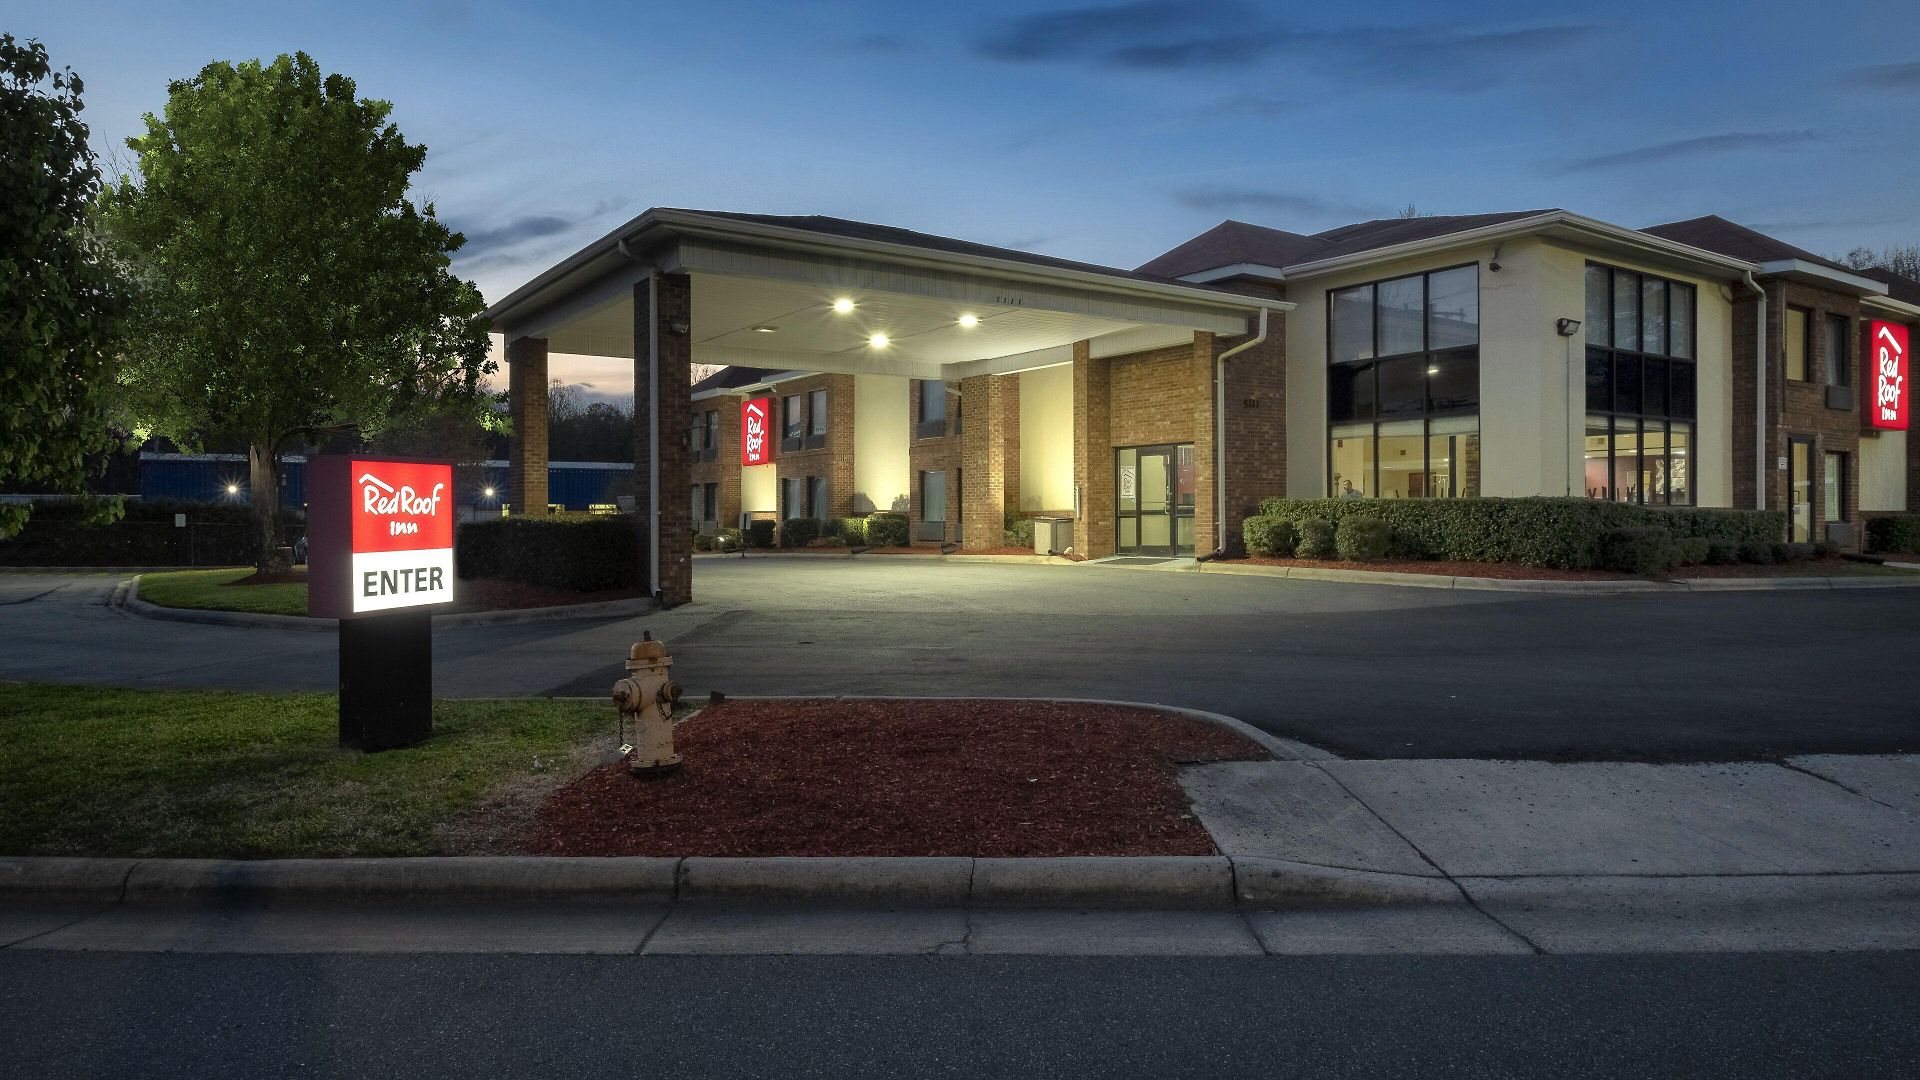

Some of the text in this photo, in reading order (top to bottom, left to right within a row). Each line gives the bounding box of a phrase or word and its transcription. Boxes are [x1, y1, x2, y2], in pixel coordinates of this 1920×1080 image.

[1879, 347, 1899, 377] Red
[1878, 375, 1903, 409] Roof
[747, 416, 762, 434] Red
[746, 430, 765, 454] Roof
[363, 483, 444, 517] Red Roof
[363, 566, 444, 597] ENTER
